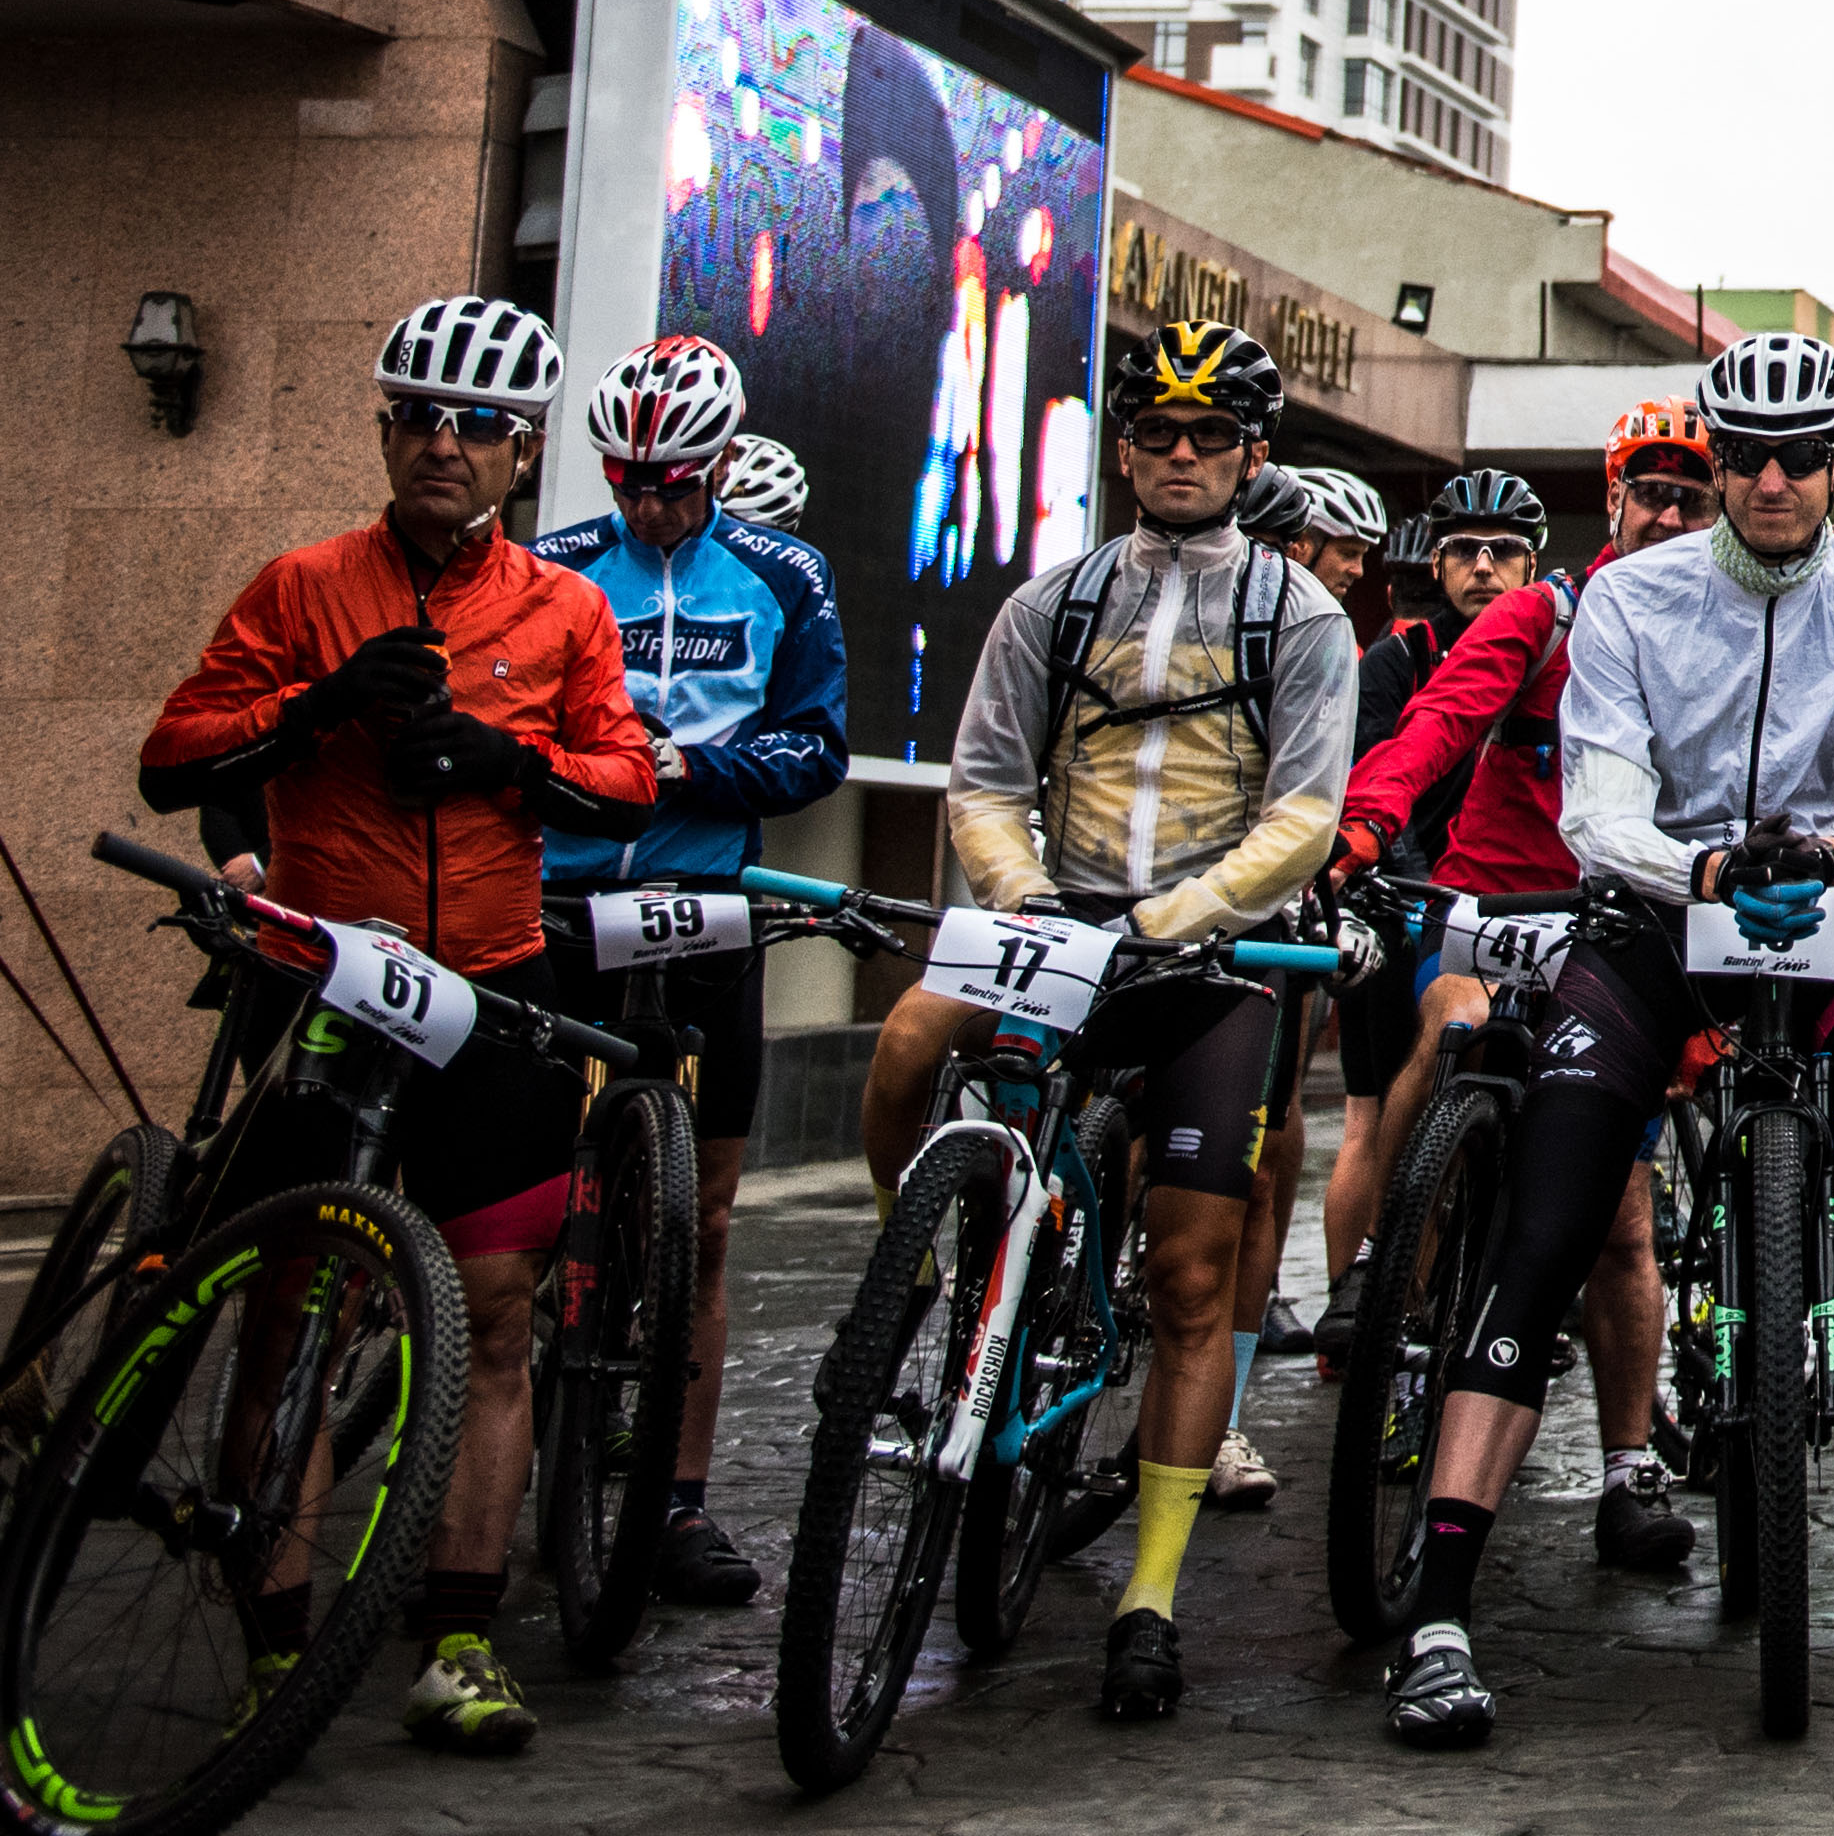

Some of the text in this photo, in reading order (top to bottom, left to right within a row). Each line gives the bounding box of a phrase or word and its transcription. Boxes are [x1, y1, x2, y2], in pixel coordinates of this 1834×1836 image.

[535, 528, 601, 556] FRIDAY
[727, 526, 780, 556] FAST
[622, 628, 653, 653] ST
[639, 897, 706, 944] 59
[993, 936, 1050, 993] 17
[1488, 924, 1541, 972] 41
[1723, 955, 1766, 972] Santini
[381, 957, 433, 1025] 61
[319, 1204, 393, 1259] MAXXIS
[970, 1333, 1008, 1421] ROCKSHOX
